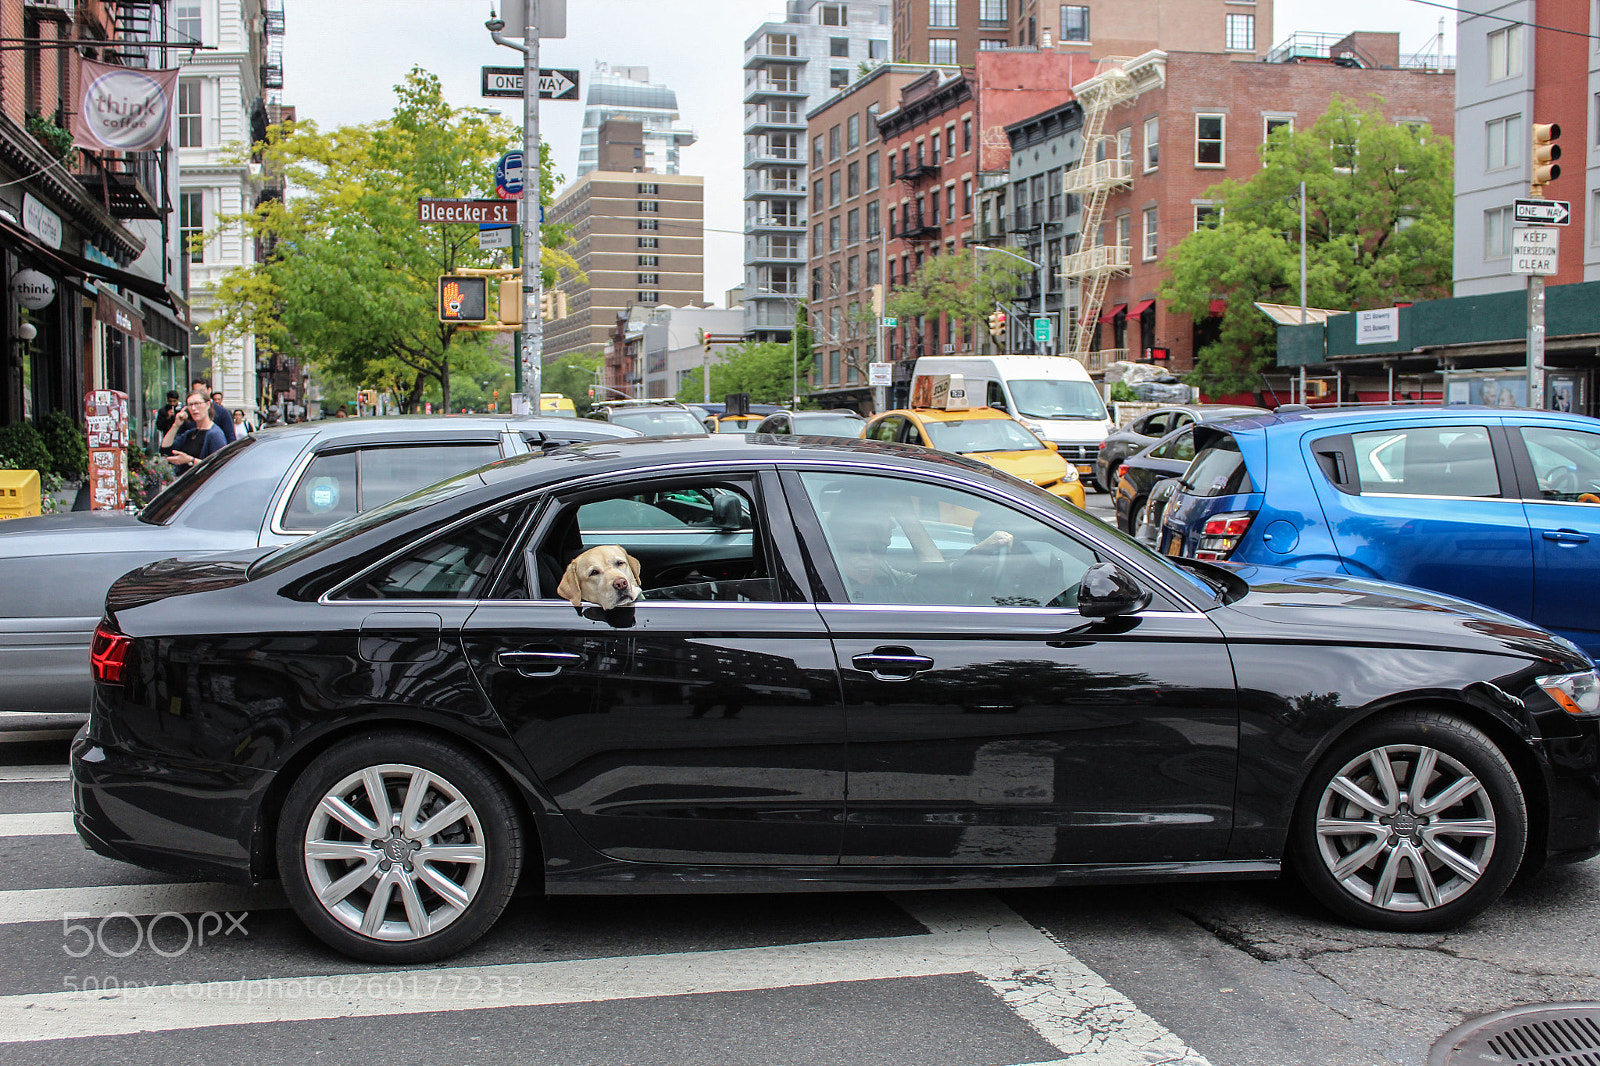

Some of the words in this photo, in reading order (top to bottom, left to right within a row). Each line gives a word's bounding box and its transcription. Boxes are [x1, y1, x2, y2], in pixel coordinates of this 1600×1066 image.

[495, 76, 523, 88] ONE
[539, 78, 565, 90] WAY
[95, 94, 156, 116] think
[103, 118, 147, 128] coffee
[421, 203, 488, 221] Bleecker
[493, 205, 508, 221] St
[1518, 206, 1537, 216] ONE
[1545, 208, 1564, 217] WAY
[1523, 232, 1548, 243] KEEP
[1514, 246, 1556, 256] INTERSECTION
[1519, 259, 1550, 269] CLEAR
[17, 283, 49, 294] think
[933, 381, 948, 396] SOLO
